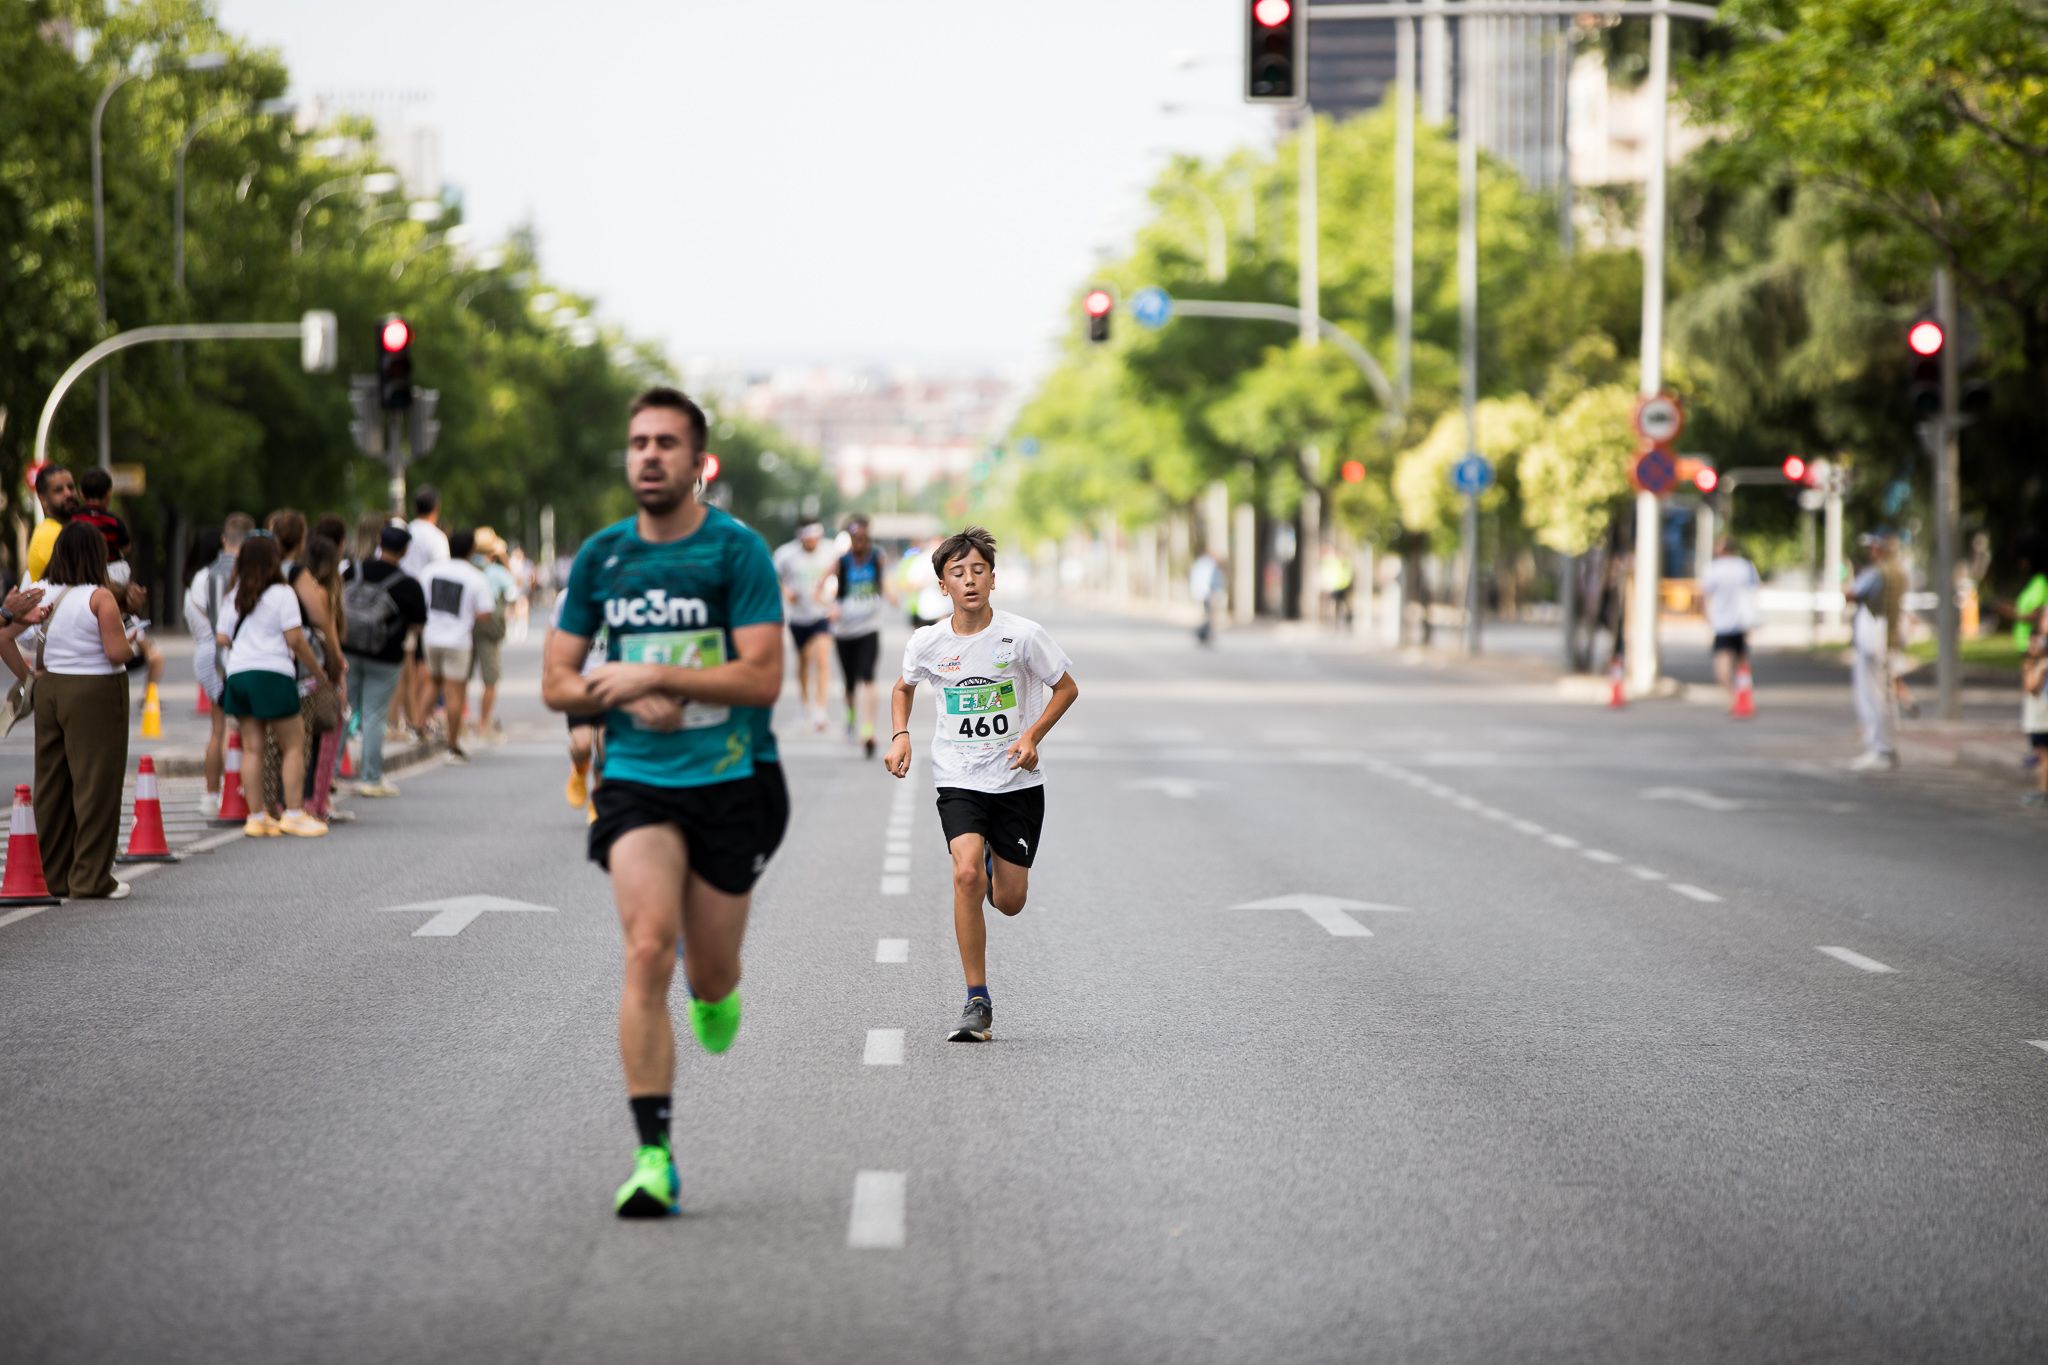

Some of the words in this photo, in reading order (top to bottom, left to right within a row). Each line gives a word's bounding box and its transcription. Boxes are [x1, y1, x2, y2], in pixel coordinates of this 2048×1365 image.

[605, 589, 708, 627] uc3m
[958, 691, 1002, 712] ELA
[958, 713, 1009, 738] 460
